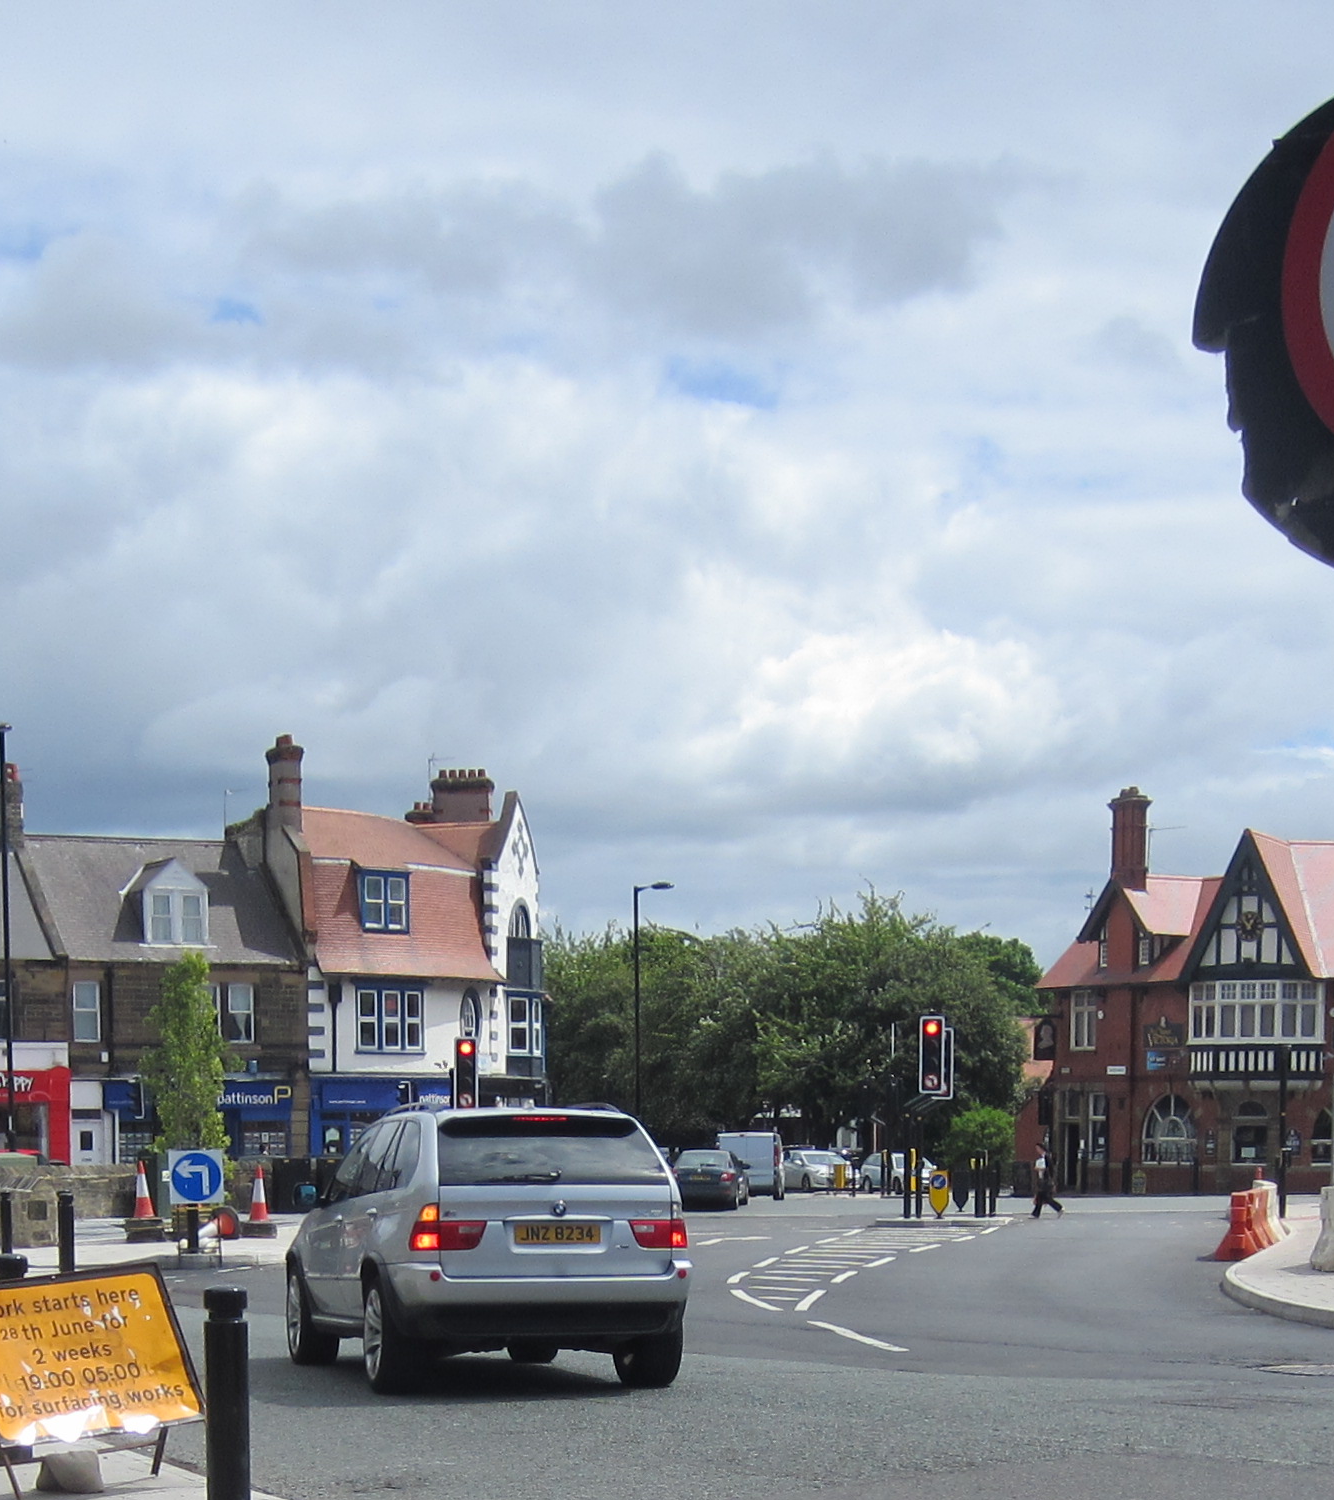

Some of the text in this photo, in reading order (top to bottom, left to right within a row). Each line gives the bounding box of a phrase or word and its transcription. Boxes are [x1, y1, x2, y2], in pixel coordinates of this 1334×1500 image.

[217, 1092, 273, 1107] pattinson
[555, 1226, 595, 1241] 8234
[34, 1294, 89, 1314] starts
[96, 1287, 139, 1306] here
[51, 1318, 95, 1338] June
[101, 1312, 128, 1331] for
[32, 1341, 112, 1365] 2 weeks
[19, 1370, 76, 1392] 19:00
[82, 1360, 141, 1384] 05:00
[32, 1392, 122, 1416] surfacing
[127, 1382, 185, 1404] works
